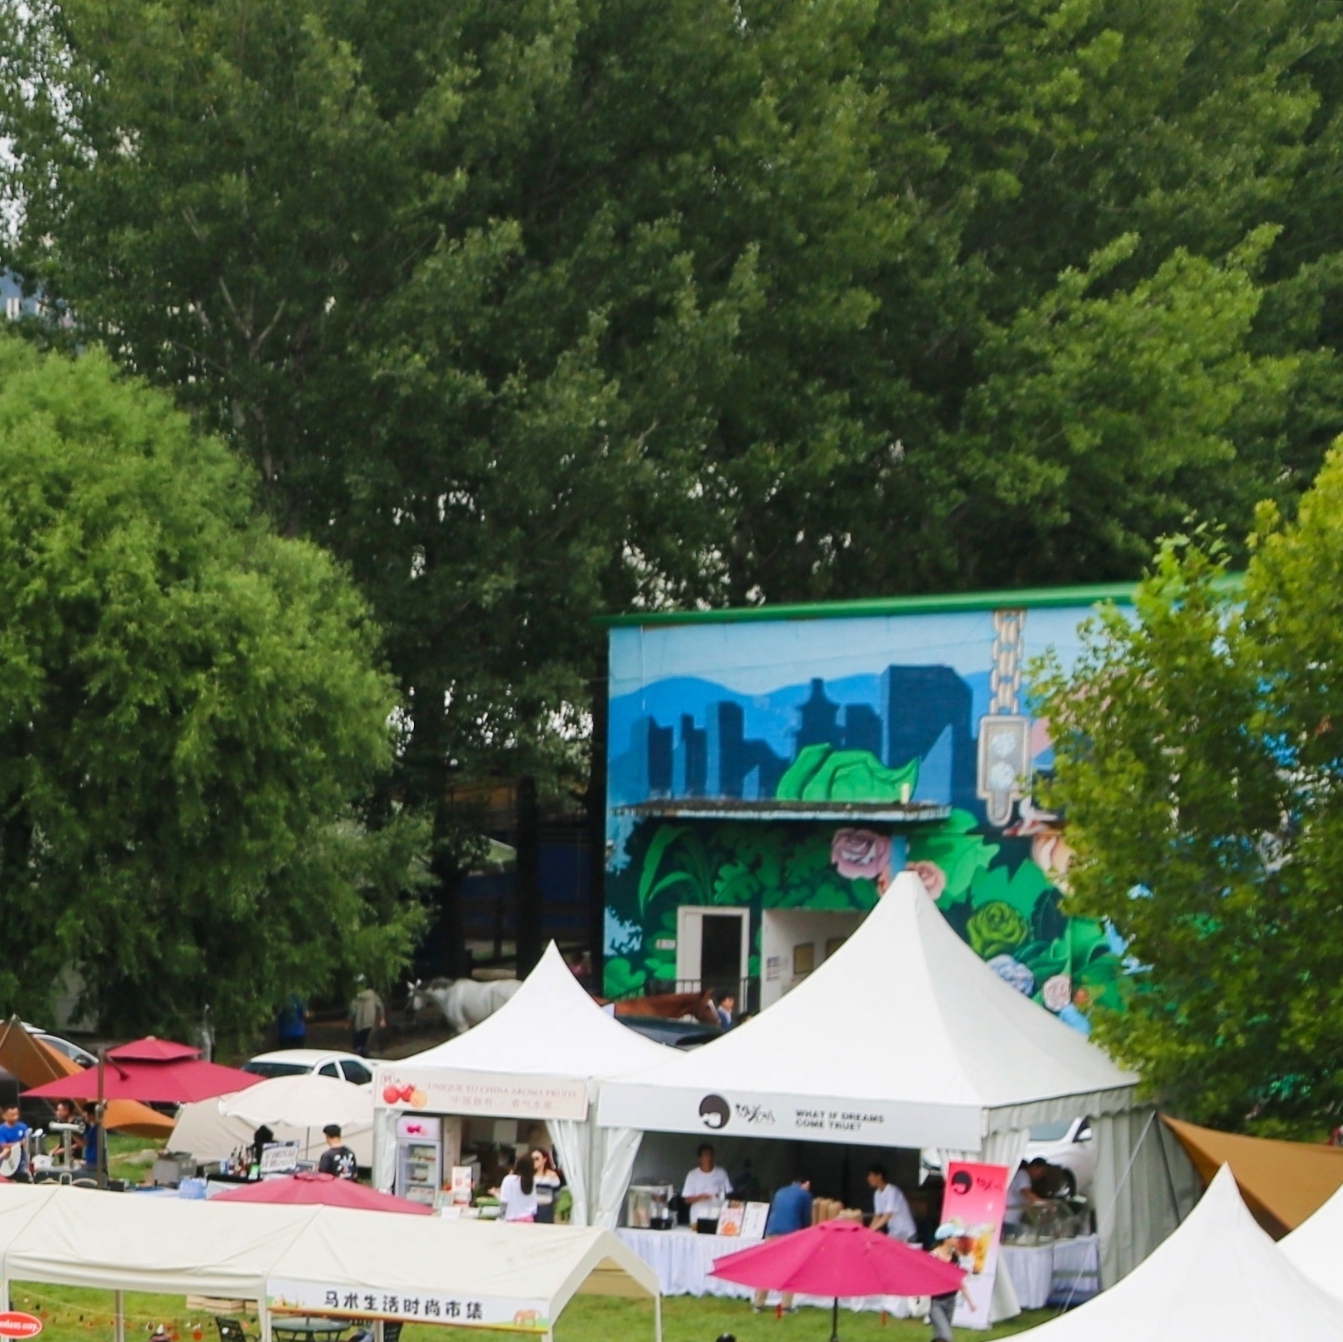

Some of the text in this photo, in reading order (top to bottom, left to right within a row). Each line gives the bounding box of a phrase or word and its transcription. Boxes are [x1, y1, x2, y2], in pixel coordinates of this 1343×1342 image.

[466, 1084, 478, 1092] TO
[480, 1085, 509, 1094] CHINA
[511, 1087, 544, 1096] AROMA
[796, 1109, 884, 1123] WHAT IF DREAMS
[796, 1119, 824, 1128] COME
[325, 1291, 483, 1319] 马术生活时尚市集
